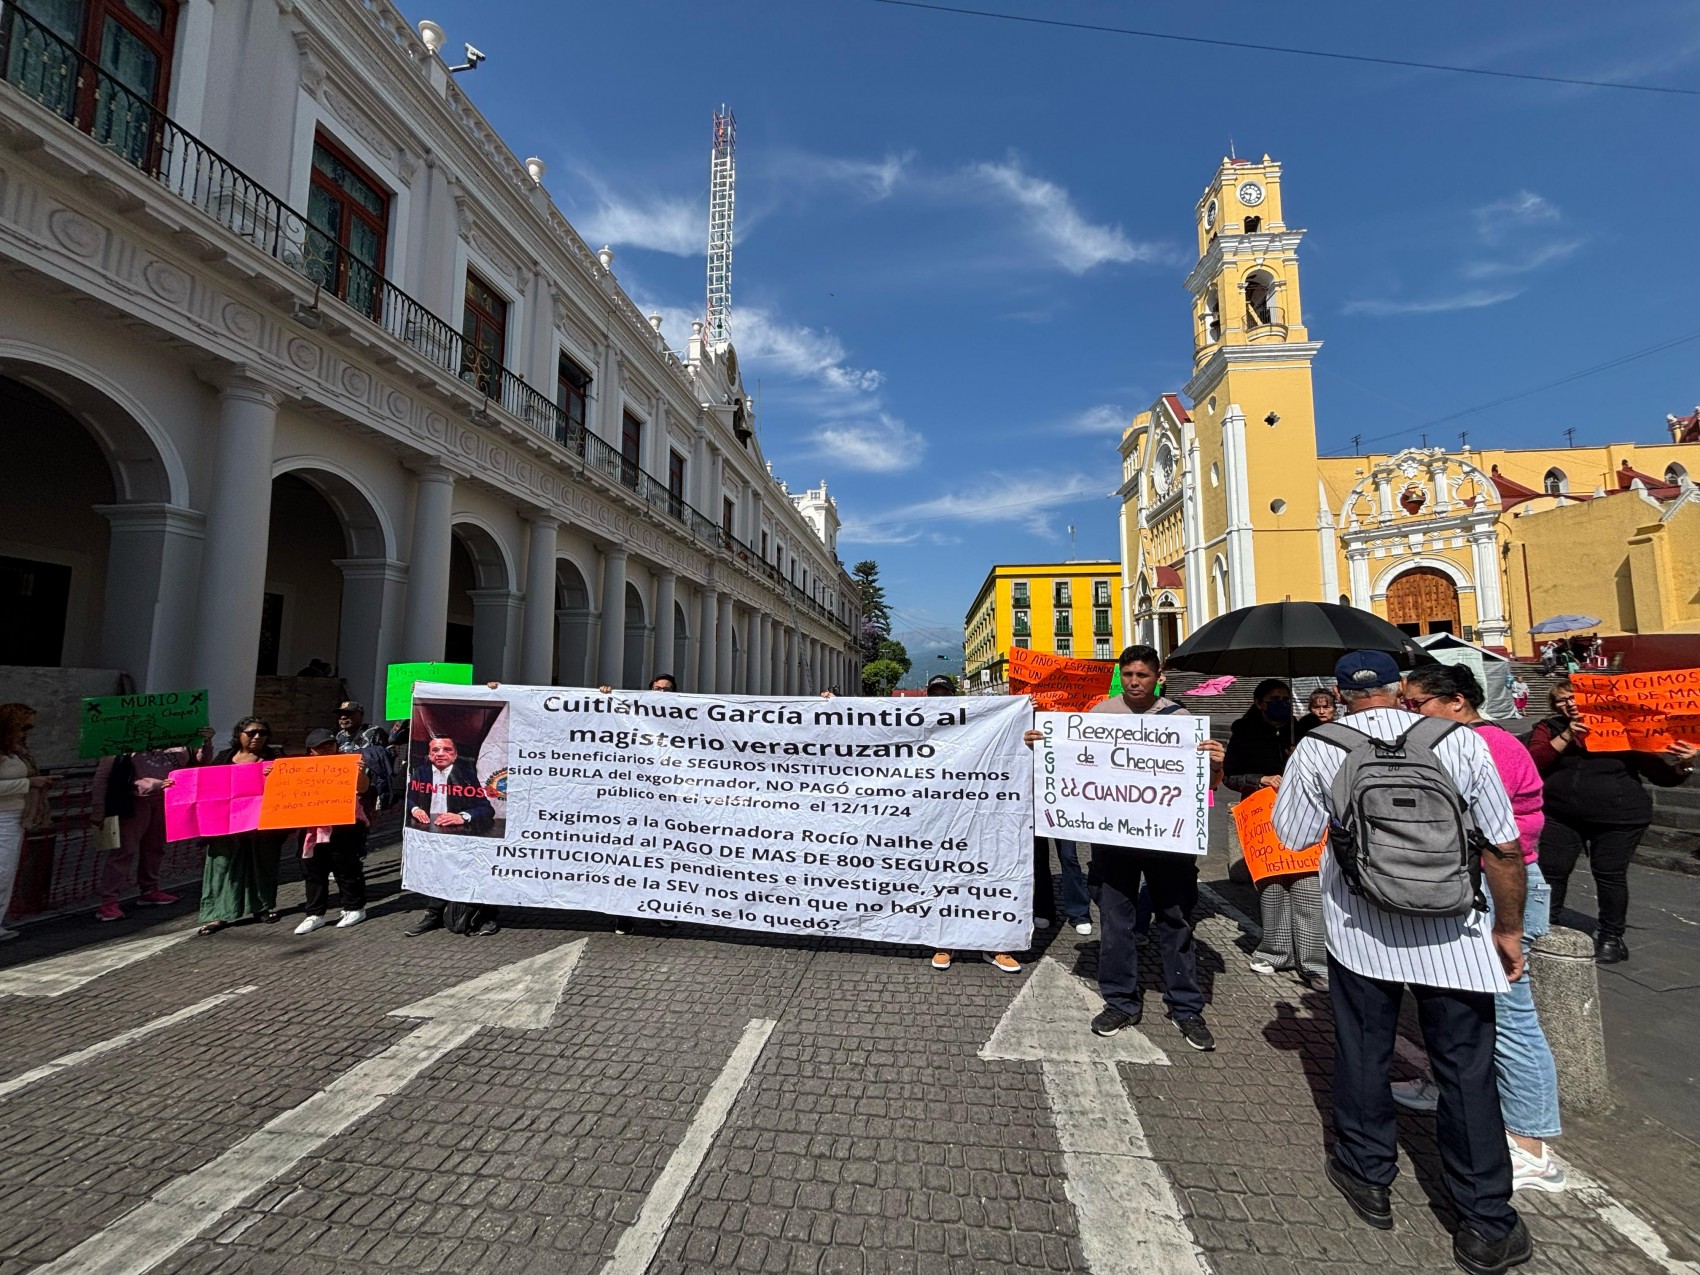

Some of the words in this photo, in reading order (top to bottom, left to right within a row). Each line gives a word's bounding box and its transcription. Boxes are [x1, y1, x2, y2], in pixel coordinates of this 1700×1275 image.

[1013, 666, 1023, 675] NI
[1028, 670, 1043, 680] UN
[1015, 650, 1028, 662] 10
[1064, 661, 1114, 674] ESPERANDO
[121, 692, 179, 708] MURIO
[543, 696, 698, 720] Cuitláhuac
[707, 703, 802, 725] García
[814, 706, 925, 727] mintió
[936, 708, 967, 726] al
[1584, 693, 1629, 704] PAGO
[1637, 691, 1660, 700] DE
[569, 728, 724, 751] magisterio
[732, 740, 936, 759] veracruzano
[1067, 714, 1181, 747] Reexpedición
[518, 749, 546, 760] Los
[551, 750, 655, 766] beneficiarios
[660, 755, 683, 768] de
[687, 757, 766, 772] SEGUROS
[771, 763, 935, 780] INSTITUCIONALES
[942, 768, 1010, 781] hemos
[1043, 720, 1057, 805] SEGURO
[1077, 746, 1095, 764] de
[1110, 747, 1185, 776] Cheques
[509, 765, 543, 776] sido
[548, 767, 603, 779] BURLA
[608, 768, 632, 781] del
[636, 772, 760, 792] exgobernador,
[766, 780, 794, 792] NO
[799, 778, 849, 795] PAGÓ
[855, 785, 906, 797] como
[912, 788, 989, 801] alardeo
[995, 790, 1020, 801] en
[596, 786, 655, 800] público
[658, 793, 677, 802] en
[682, 794, 699, 805] el
[704, 795, 800, 811] velódromo
[810, 801, 825, 812] el
[832, 801, 912, 818] 12/11/24
[538, 809, 621, 825] Exigimos
[627, 816, 638, 826] a
[644, 814, 659, 828] la
[665, 818, 794, 841] Gobernadora
[801, 829, 858, 846] Rocío
[866, 834, 933, 850] Nalhe
[940, 837, 968, 851] dé
[1098, 816, 1114, 831] de
[1117, 818, 1168, 838] Mentir
[1243, 819, 1275, 844] Exigim
[521, 829, 634, 846] continuidad
[640, 836, 657, 849] al
[663, 838, 712, 856] PAGO
[719, 845, 745, 859] DE
[752, 850, 797, 863] MAS
[803, 852, 829, 866] DE
[836, 854, 875, 869] 800
[881, 857, 989, 875] SEGUROS
[1249, 845, 1273, 863] Pago
[496, 846, 664, 869] INSTITUCIONALES
[670, 860, 779, 884] pendientes
[785, 874, 797, 885] e
[803, 873, 926, 896] investigue,
[932, 883, 959, 897] ya
[967, 885, 1019, 901] que,
[491, 865, 610, 885] funcionarios
[614, 875, 637, 888] de
[643, 877, 660, 890] la
[666, 879, 699, 894] SEV
[705, 887, 738, 901] nos
[744, 890, 800, 907] dicen
[807, 897, 848, 912] que
[855, 901, 884, 913] no
[891, 900, 932, 918] hay
[938, 905, 1024, 925] dinero,
[637, 899, 705, 916] ¿Quién
[711, 907, 732, 919] se
[738, 908, 757, 922] lo
[763, 912, 840, 931] quedó?
